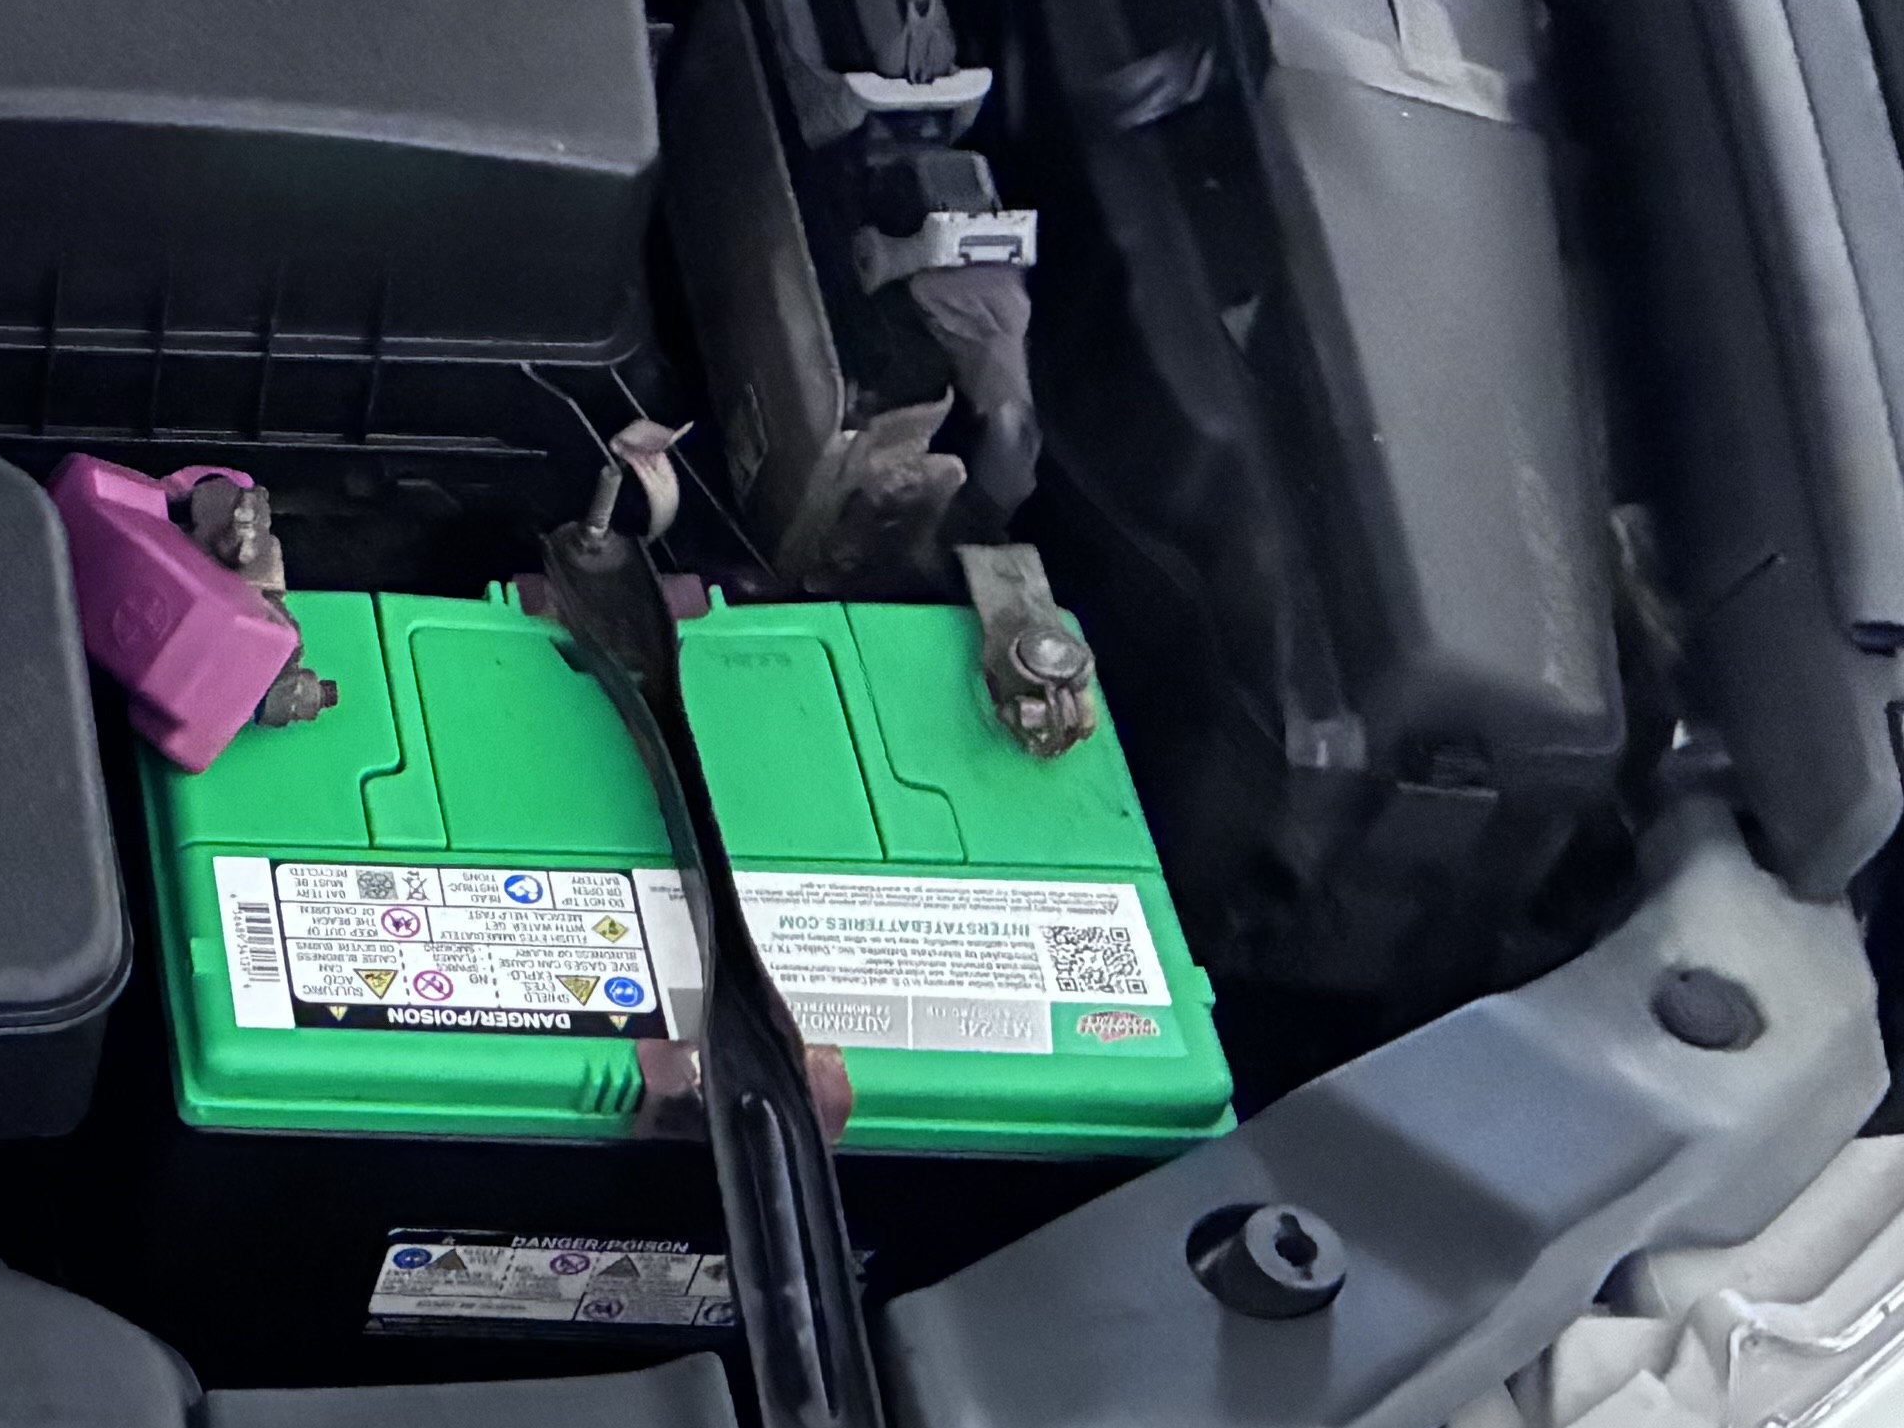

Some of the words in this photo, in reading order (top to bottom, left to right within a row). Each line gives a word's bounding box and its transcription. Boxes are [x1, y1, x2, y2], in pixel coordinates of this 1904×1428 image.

[295, 877, 309, 887] BE
[312, 878, 344, 888] MUST
[296, 888, 347, 899] BATTERY
[354, 917, 377, 927] THE
[324, 927, 347, 937] OUT
[318, 963, 343, 973] CAN
[498, 958, 535, 969] CAUSE
[323, 974, 354, 985] ACID
[386, 1007, 572, 1030] DANGER/POISON
[511, 1235, 689, 1253] DANGER/POISON
